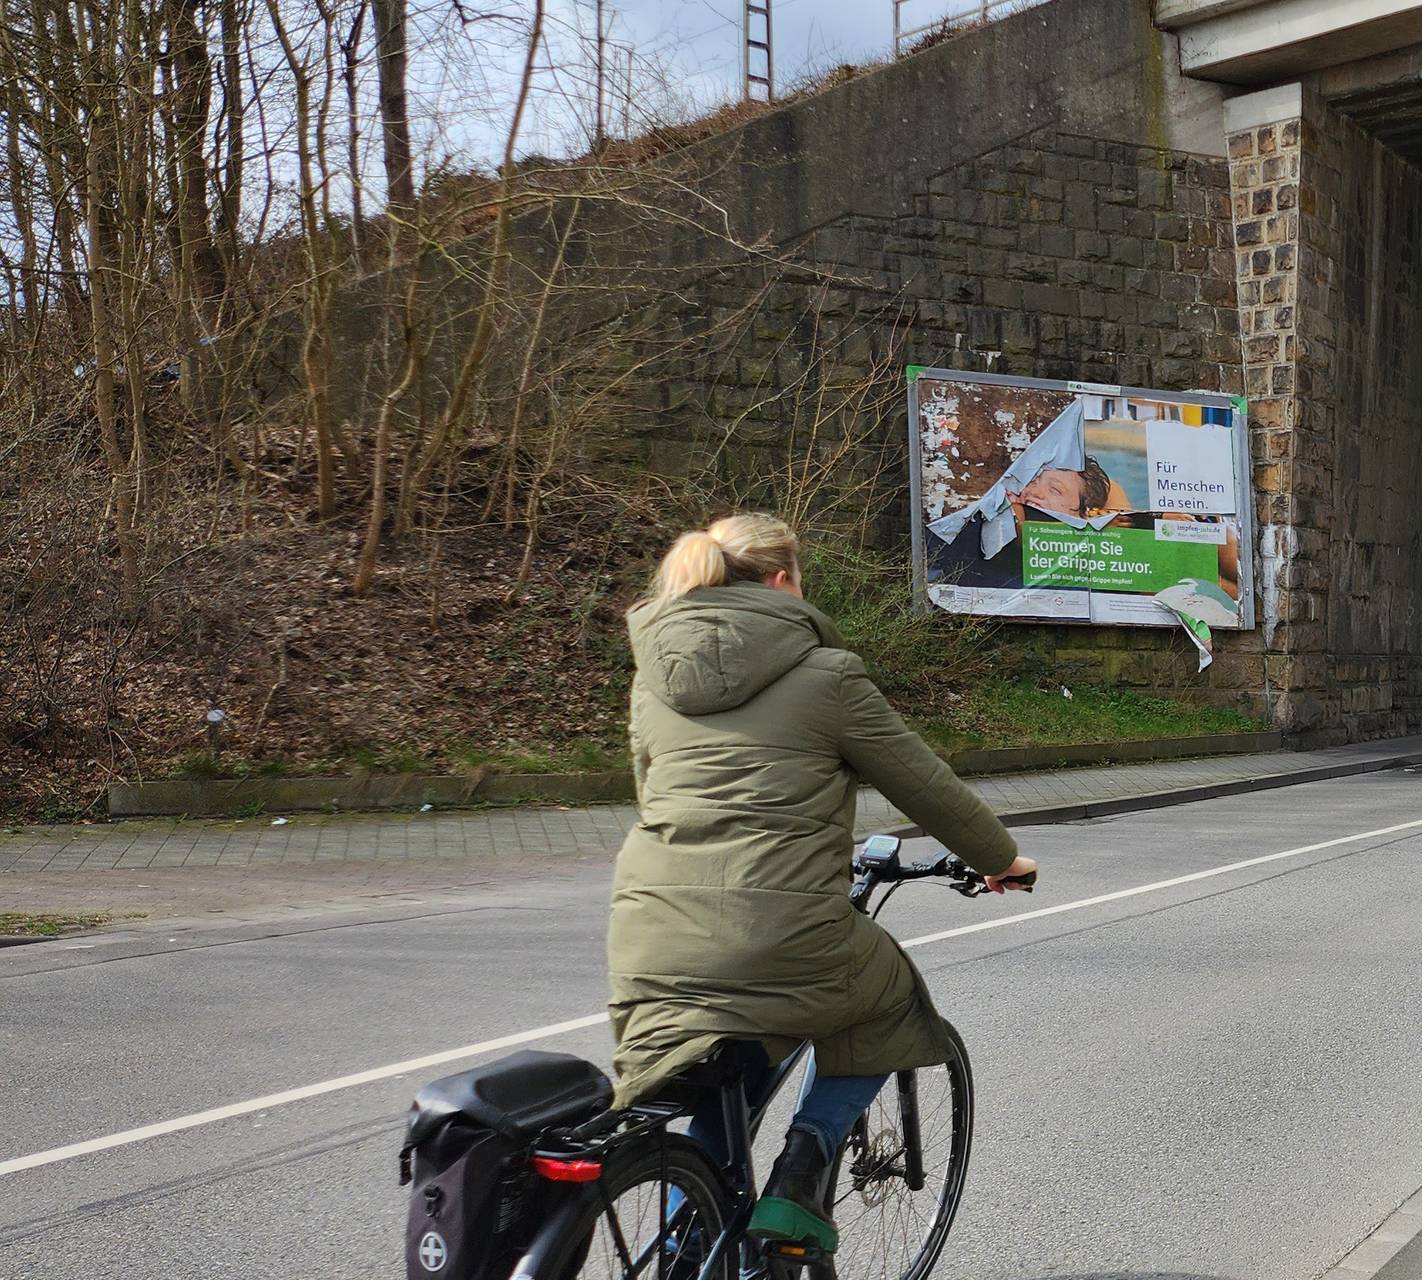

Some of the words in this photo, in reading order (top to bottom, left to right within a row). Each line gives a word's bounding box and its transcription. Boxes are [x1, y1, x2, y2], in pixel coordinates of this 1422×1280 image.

[1156, 461, 1178, 473] Für
[1157, 479, 1225, 493] Menschen
[1158, 496, 1174, 507] da
[1178, 497, 1209, 509] sein.
[1029, 537, 1096, 554] Kommen
[1100, 541, 1123, 556] Sie
[1029, 553, 1054, 568] der
[1058, 555, 1106, 573] Grippe
[1109, 560, 1153, 574] zuvor.
